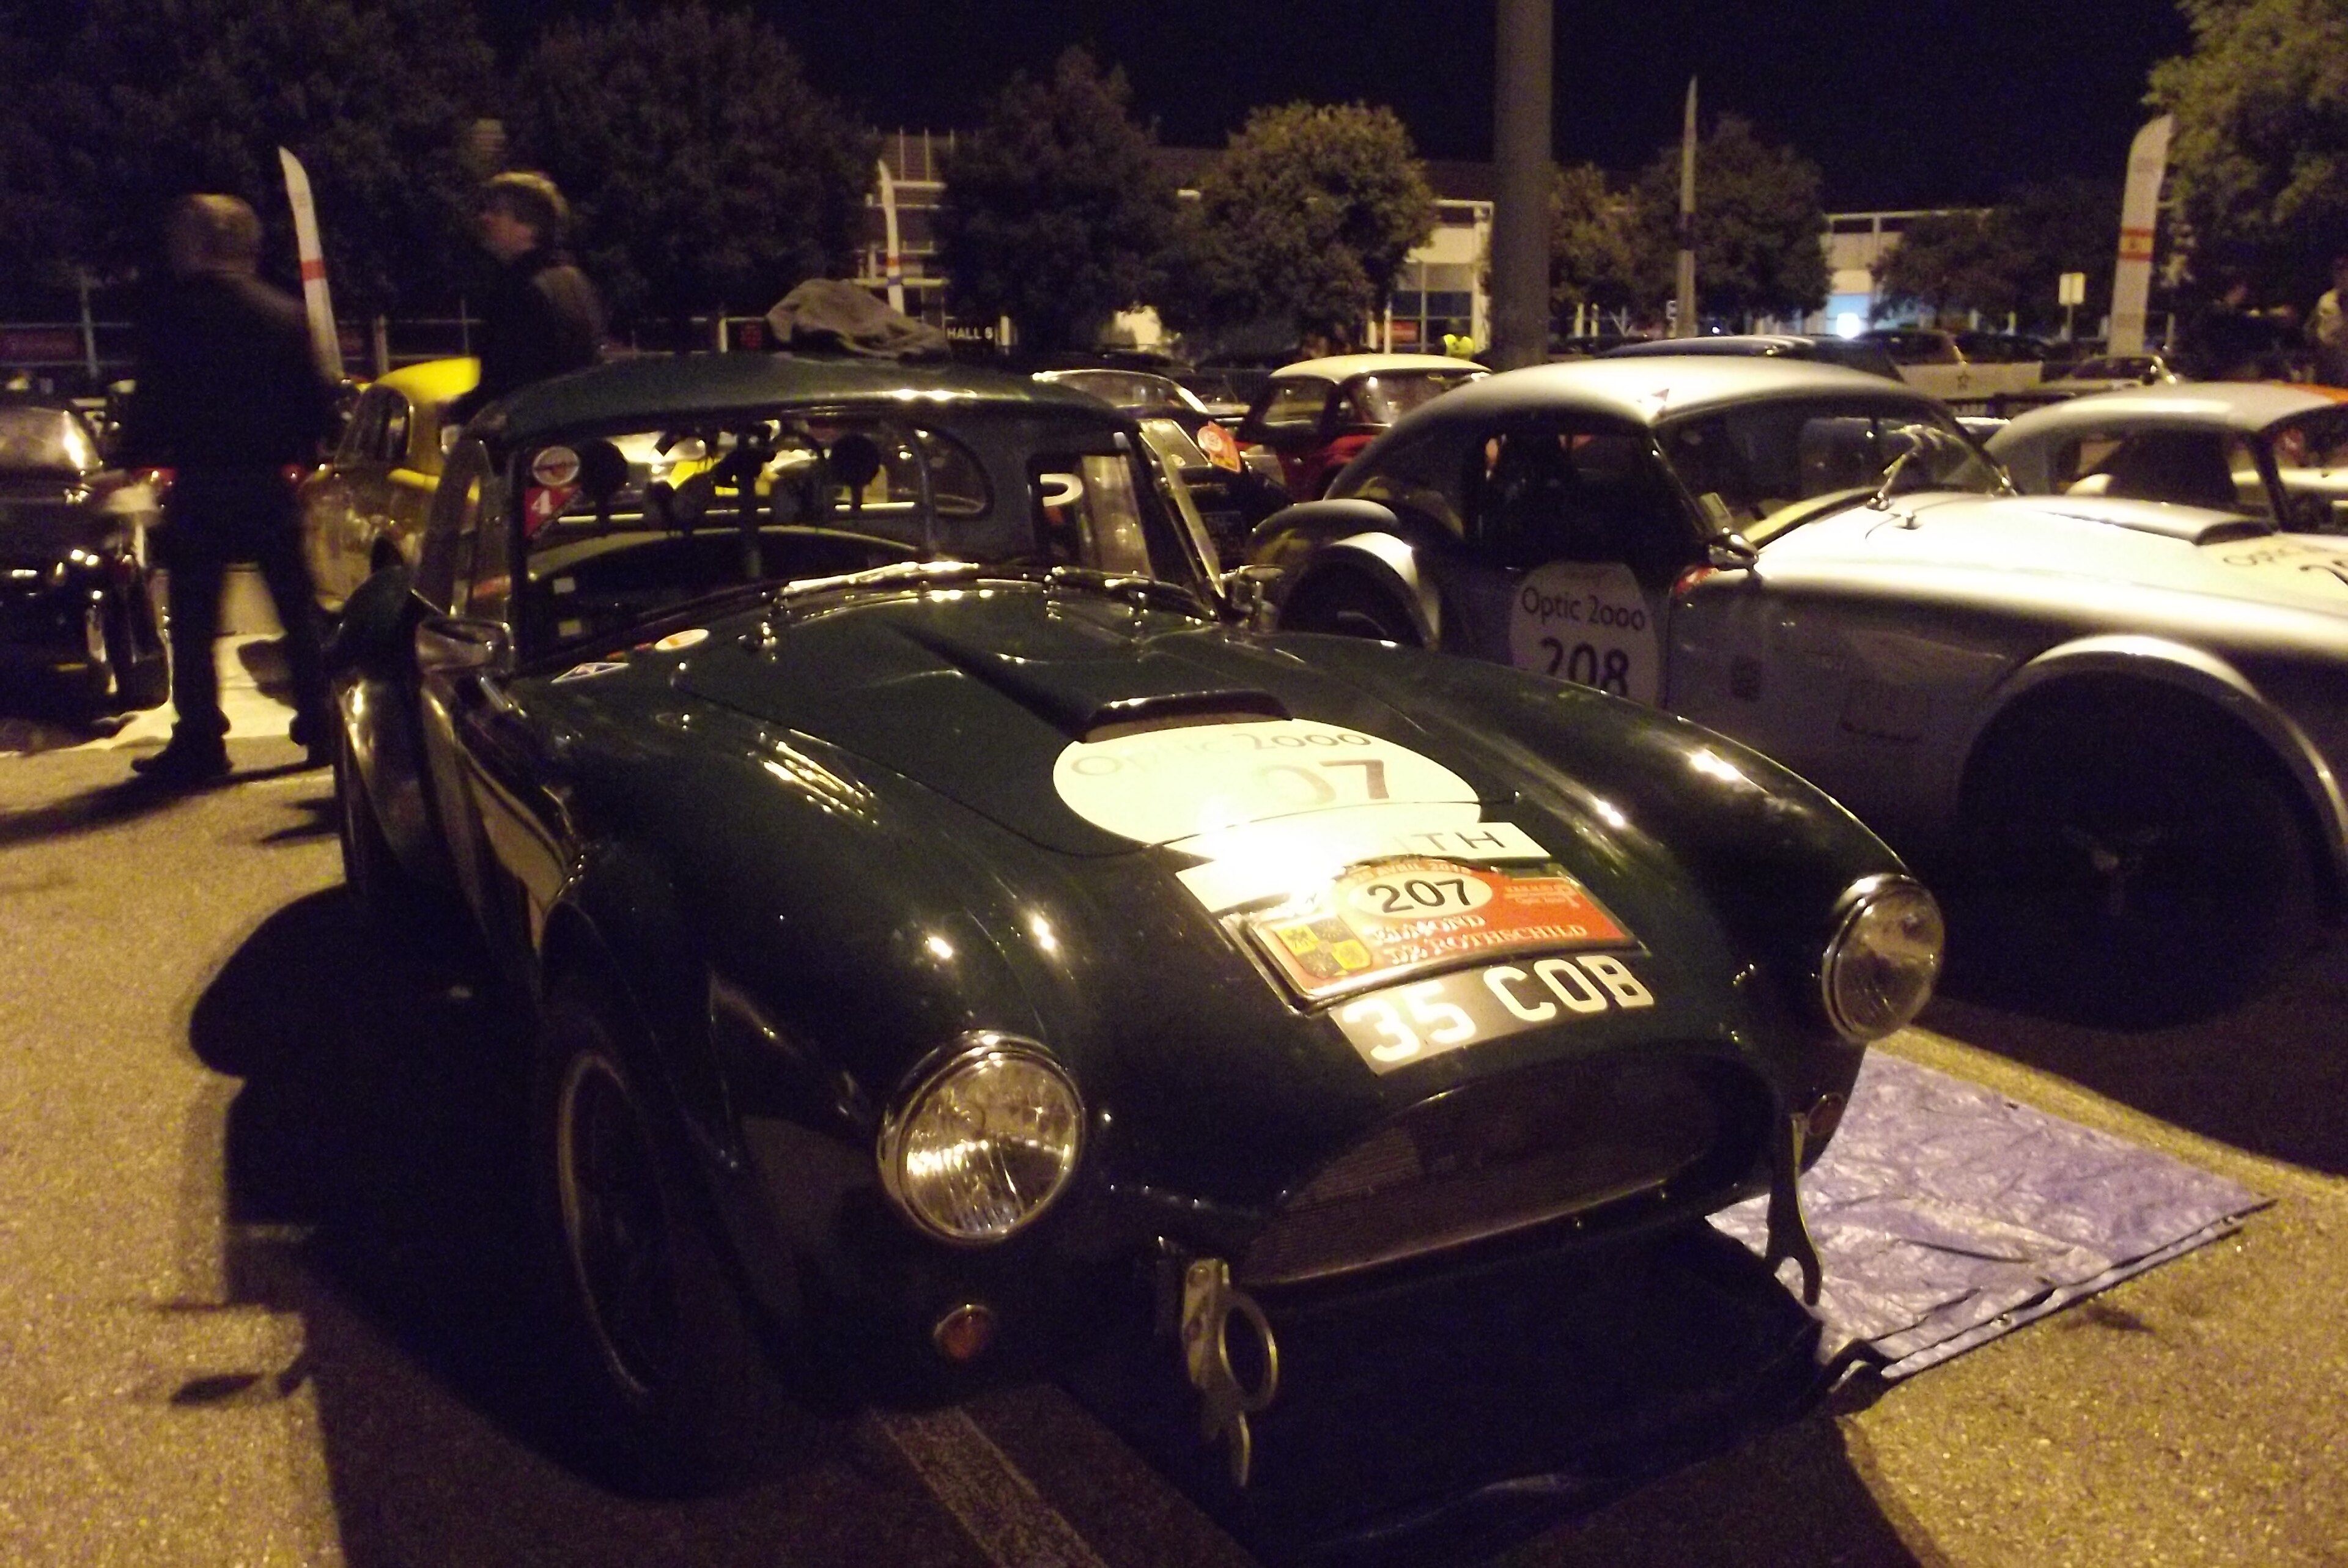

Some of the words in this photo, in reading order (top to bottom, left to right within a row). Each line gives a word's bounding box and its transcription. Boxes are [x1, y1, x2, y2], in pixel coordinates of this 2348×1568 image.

[947, 326, 982, 339] HALL
[531, 490, 552, 514] 4
[1522, 587, 1581, 625] Optic
[1588, 595, 1645, 631] 2000
[1539, 636, 1630, 697] 208
[1231, 733, 1372, 751] 2000
[1367, 878, 1471, 913] 207
[1342, 979, 1477, 1062] 35
[1483, 955, 1654, 1021] COB
